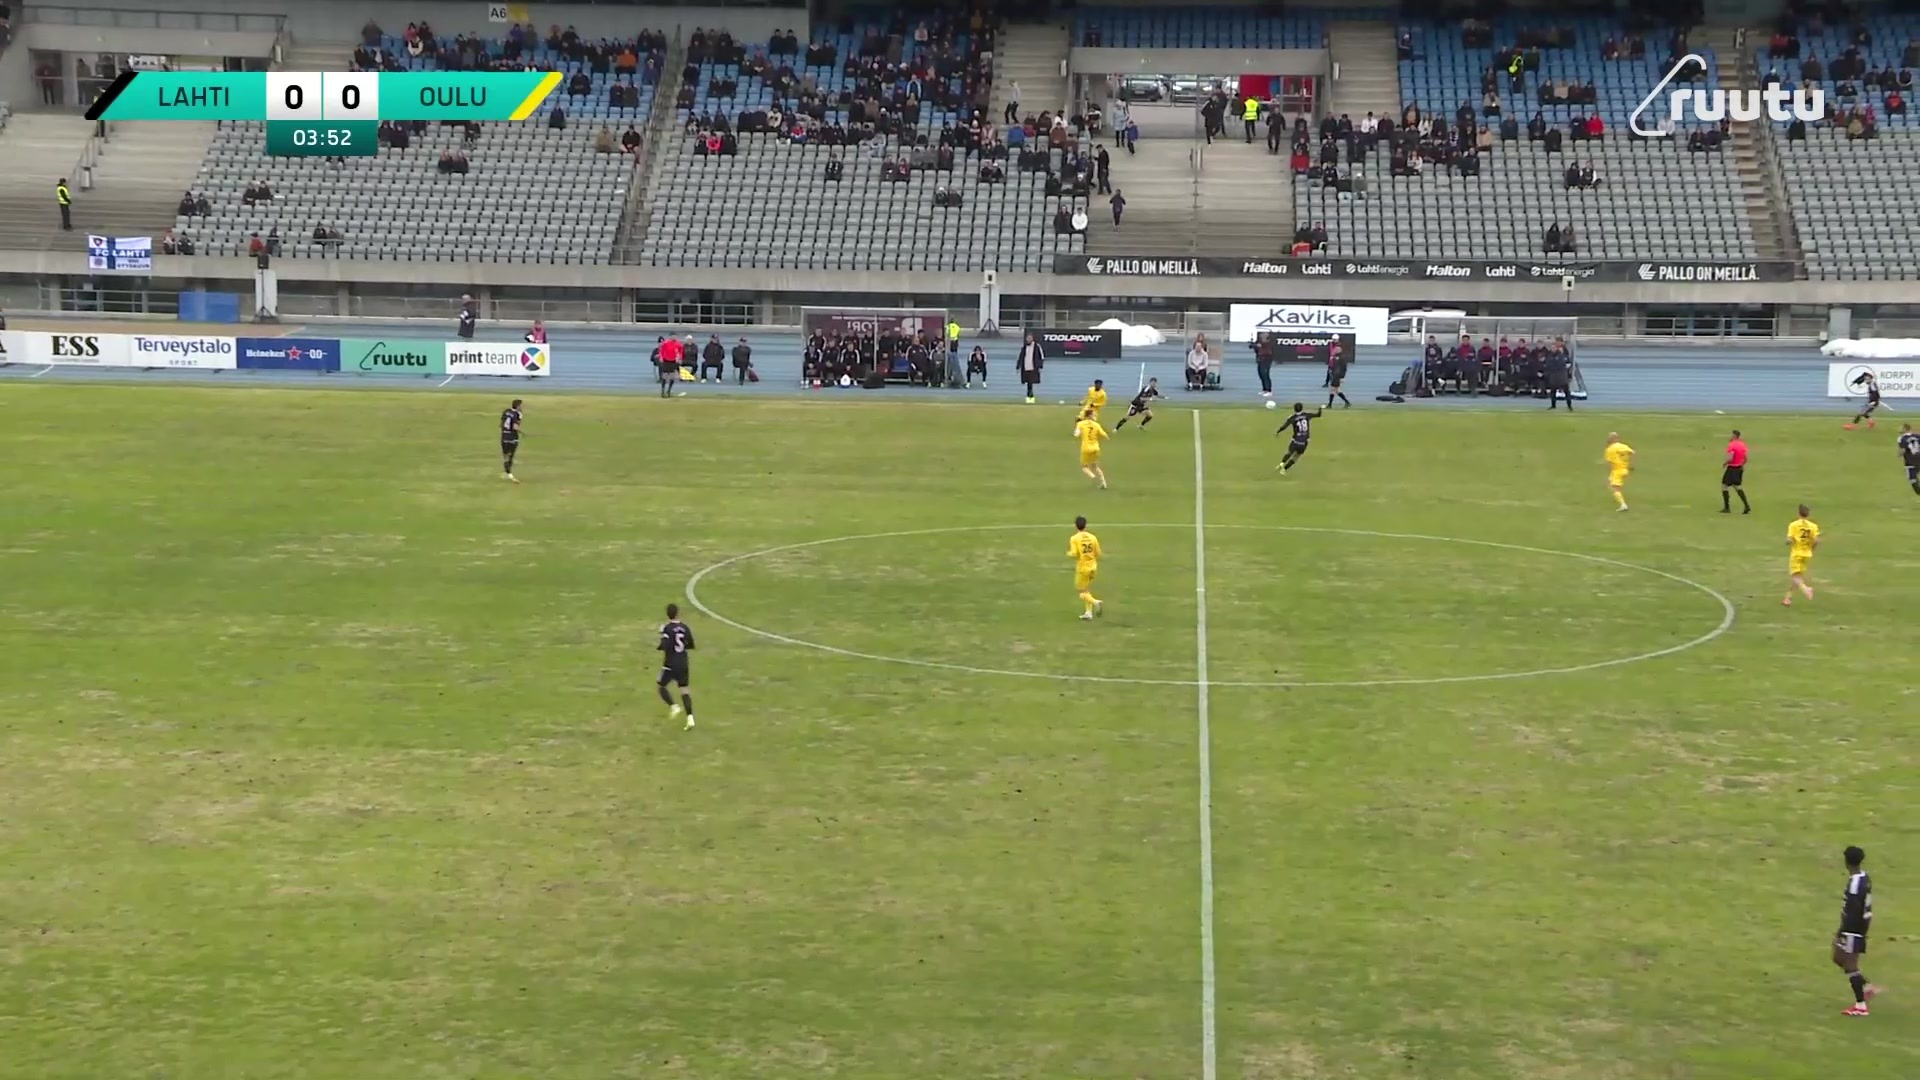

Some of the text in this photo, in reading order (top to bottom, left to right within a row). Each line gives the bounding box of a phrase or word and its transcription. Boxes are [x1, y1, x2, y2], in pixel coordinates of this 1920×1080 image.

[490, 7, 507, 19] A6
[112, 249, 145, 257] LAHTI
[1106, 258, 1201, 275] PALLO ON MEILLÄ.
[1243, 261, 1287, 274] Halton
[1302, 263, 1332, 275] Lahti
[1426, 265, 1471, 277] Halton
[1485, 265, 1516, 277] Lahti
[1658, 264, 1760, 281] PALLO ON MEILLÄ.
[1268, 308, 1351, 326] Kavika
[1043, 334, 1102, 342] TOOLPOINT
[51, 335, 99, 357] ESS
[135, 337, 231, 356] Terveystalo
[246, 349, 286, 358] Heineken
[373, 352, 427, 367] ruutu
[450, 351, 517, 366] print team
[1880, 371, 1914, 379] KORPPI
[1879, 382, 1913, 391] GROUP
[674, 633, 685, 653] 5
